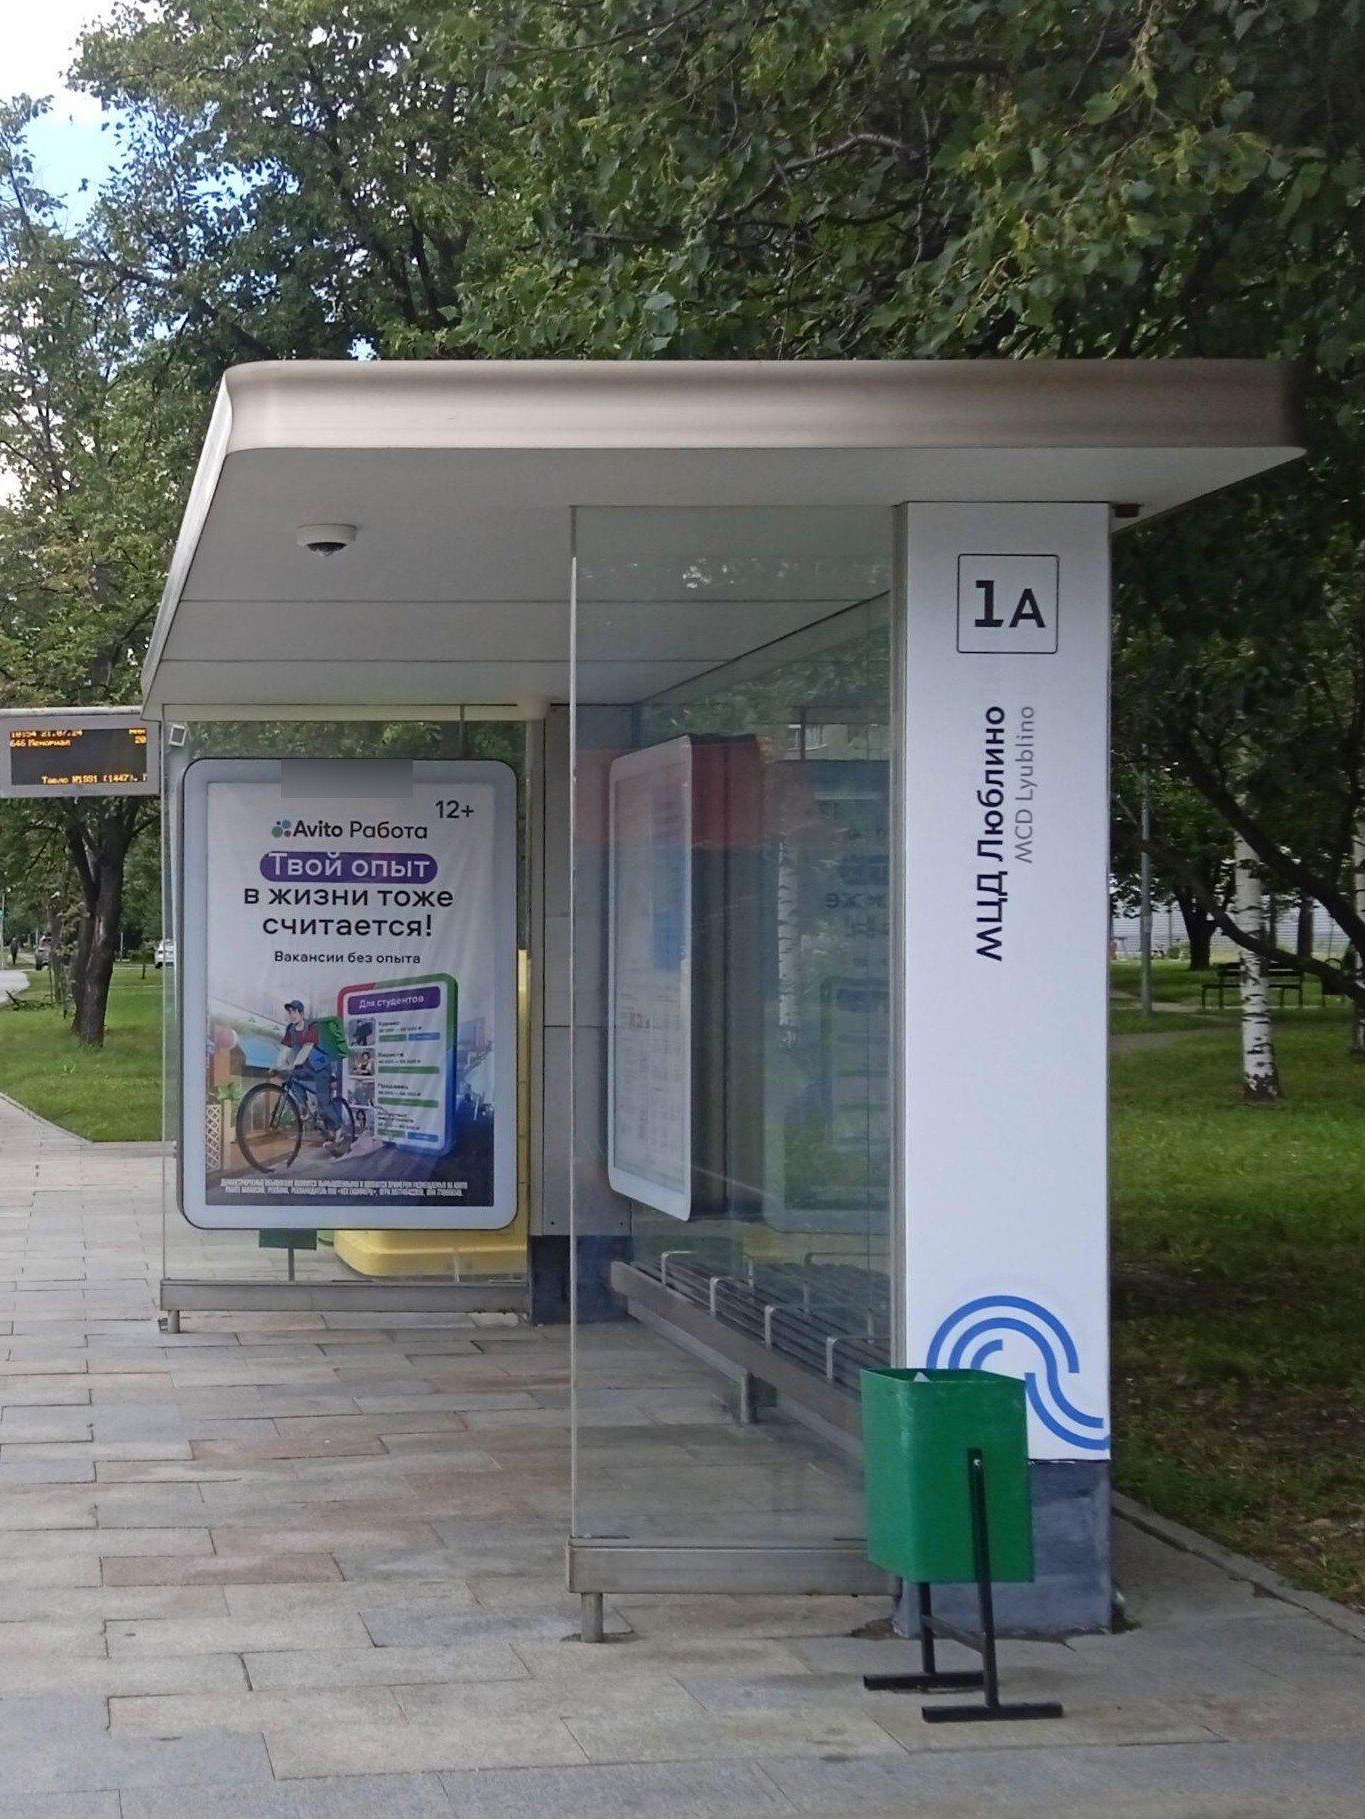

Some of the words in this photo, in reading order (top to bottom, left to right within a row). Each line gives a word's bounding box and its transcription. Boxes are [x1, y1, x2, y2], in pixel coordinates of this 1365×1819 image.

[1015, 706, 1036, 799] Lyublino
[977, 705, 1006, 862] Люблино
[436, 800, 474, 819] 12+
[293, 820, 343, 838] Avito
[350, 821, 428, 839] Работа
[1015, 808, 1033, 864] MCD
[269, 851, 342, 877] Твой
[352, 860, 430, 877] опыт
[244, 888, 259, 904] в
[269, 888, 368, 906] жизни
[378, 890, 453, 907] тоже
[263, 914, 432, 937] считается!
[977, 870, 1008, 961] МЦД
[274, 951, 343, 963] Вакансии
[348, 951, 371, 964] без
[376, 953, 420, 965] опыта
[359, 1000, 375, 1009] Для
[376, 995, 424, 1007] студентов
